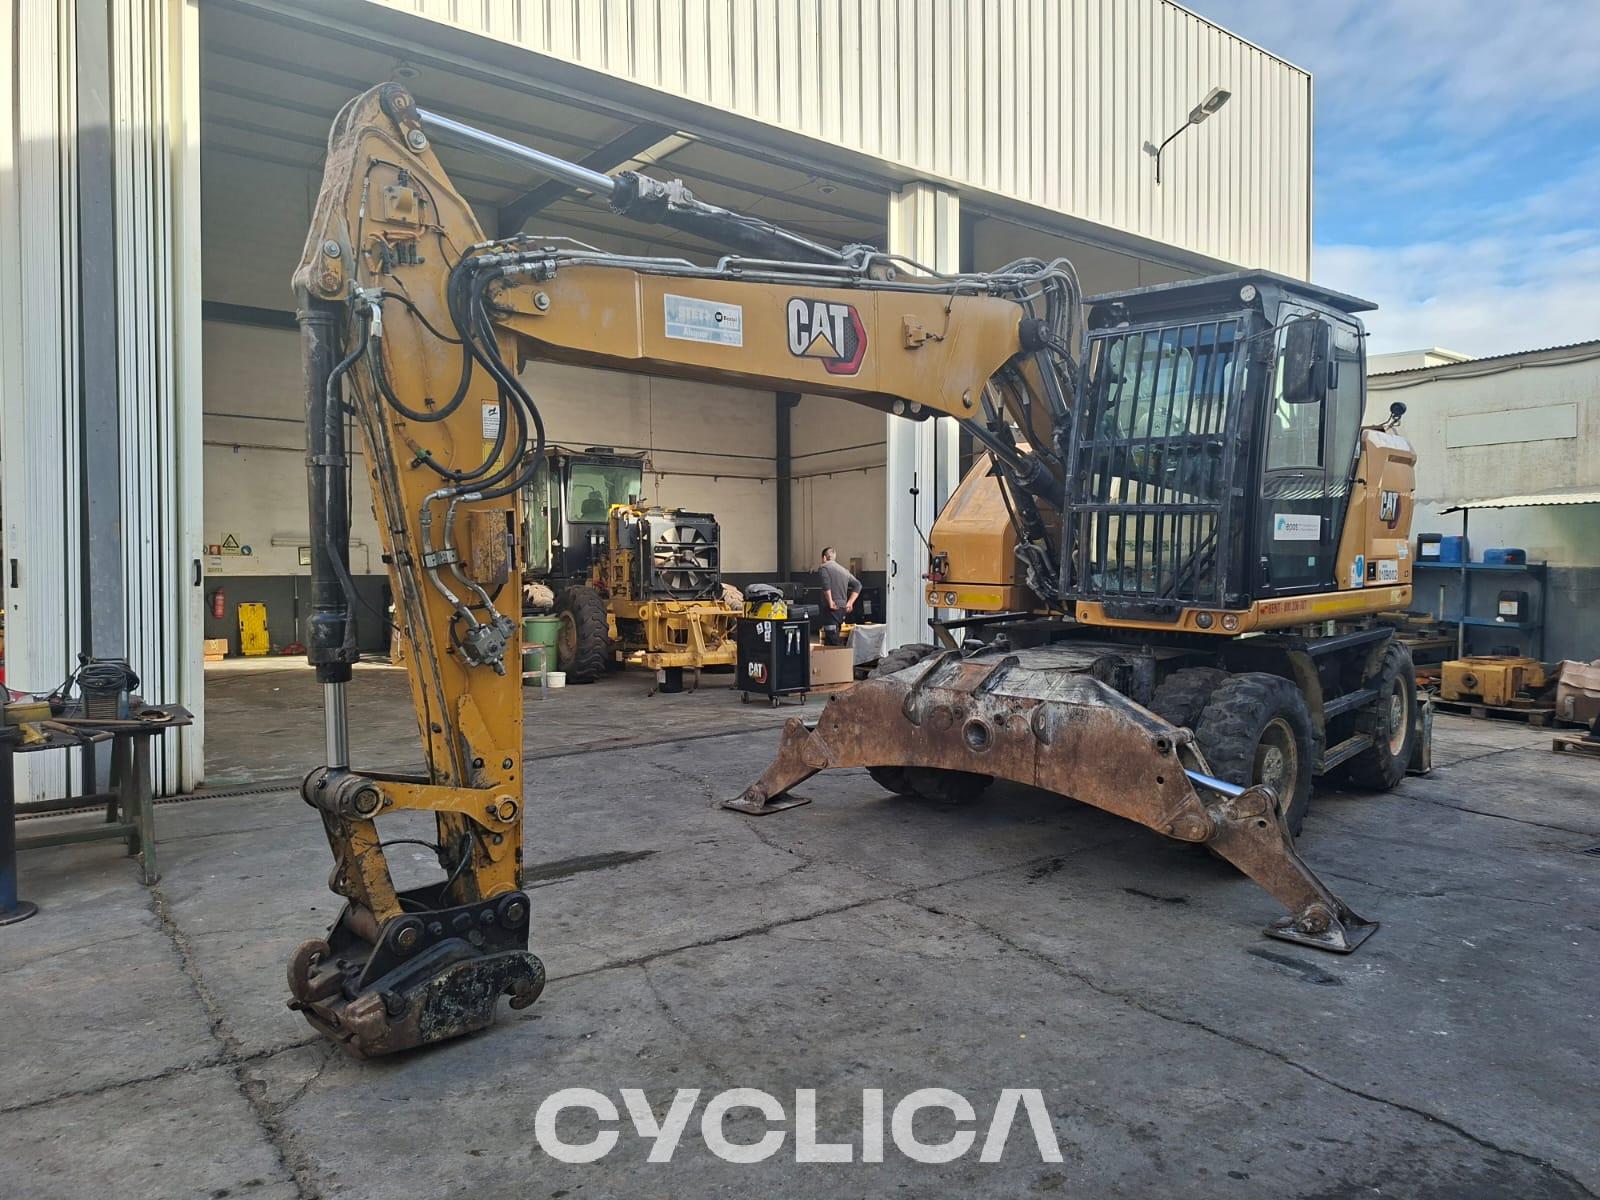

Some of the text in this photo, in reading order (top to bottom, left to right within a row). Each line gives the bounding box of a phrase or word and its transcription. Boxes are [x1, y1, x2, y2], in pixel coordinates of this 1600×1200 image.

[787, 298, 849, 359] CAT
[1380, 491, 1399, 520] CAT
[748, 662, 763, 678] CAT
